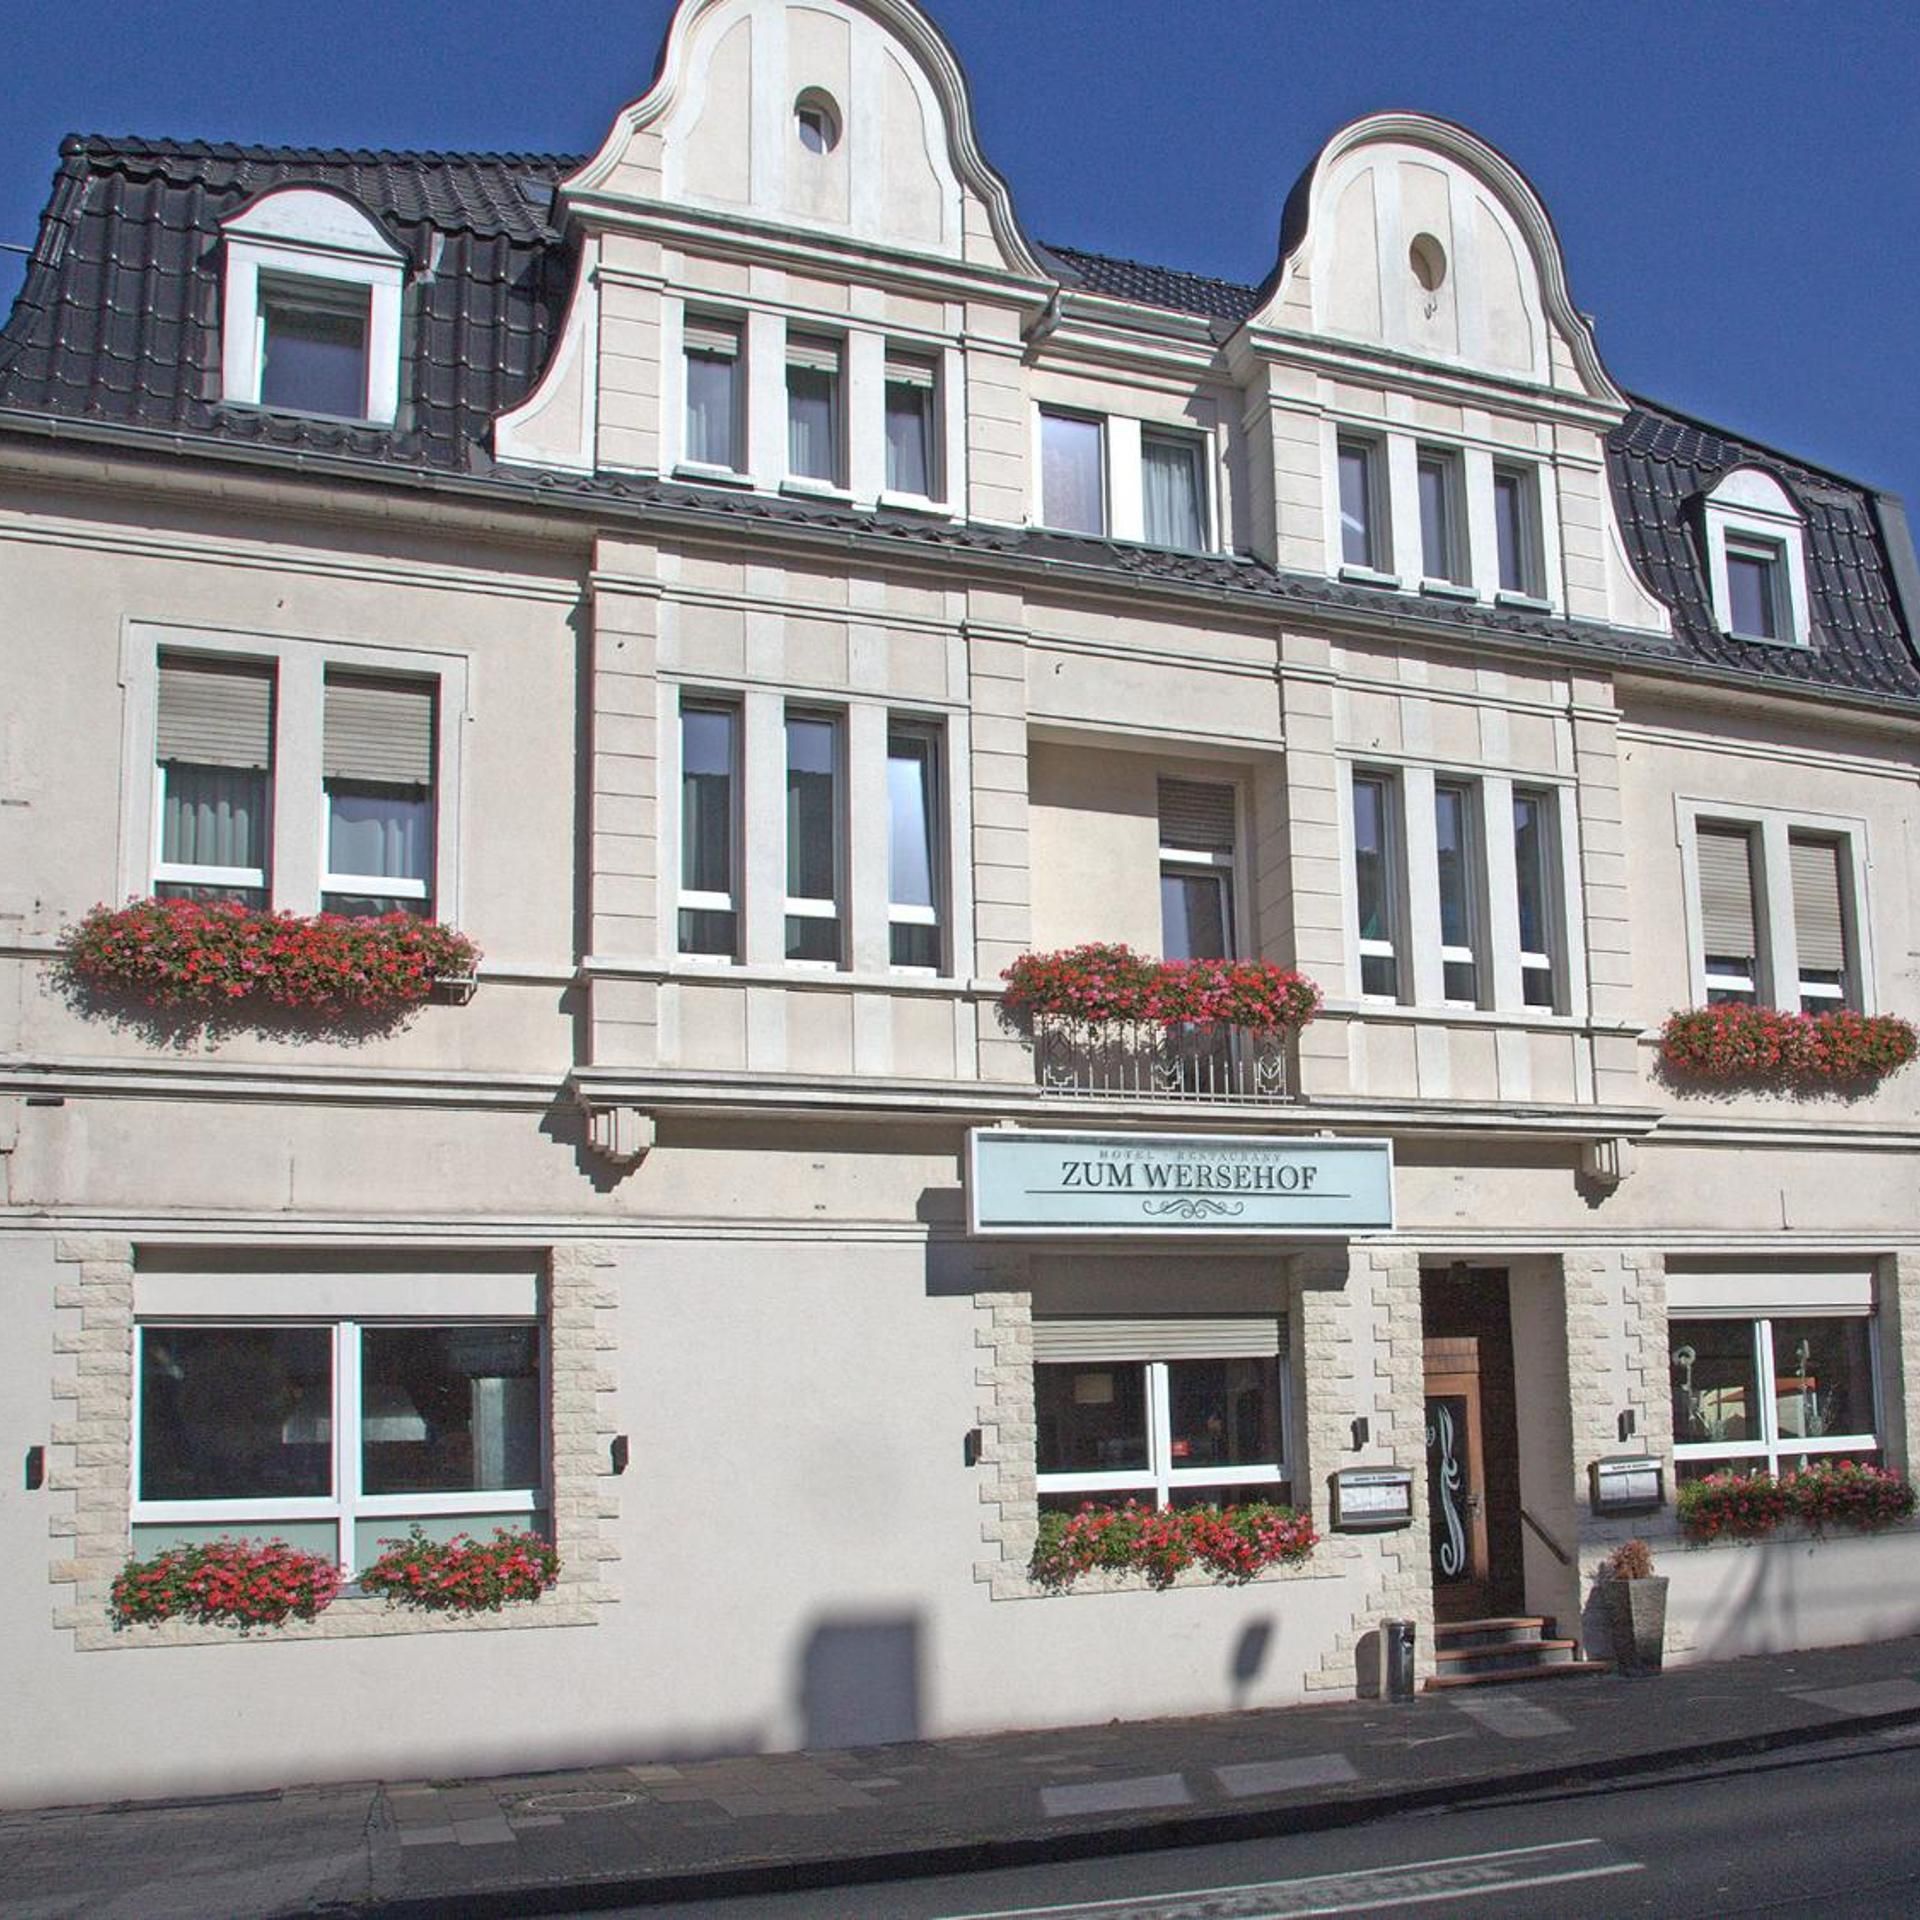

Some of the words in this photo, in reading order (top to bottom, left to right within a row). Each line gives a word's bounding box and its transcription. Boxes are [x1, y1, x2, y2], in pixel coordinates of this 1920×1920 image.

[1099, 1149, 1155, 1160] HOTEL
[1062, 1161, 1134, 1187] ZUM
[1143, 1163, 1318, 1190] WERSEHOF
